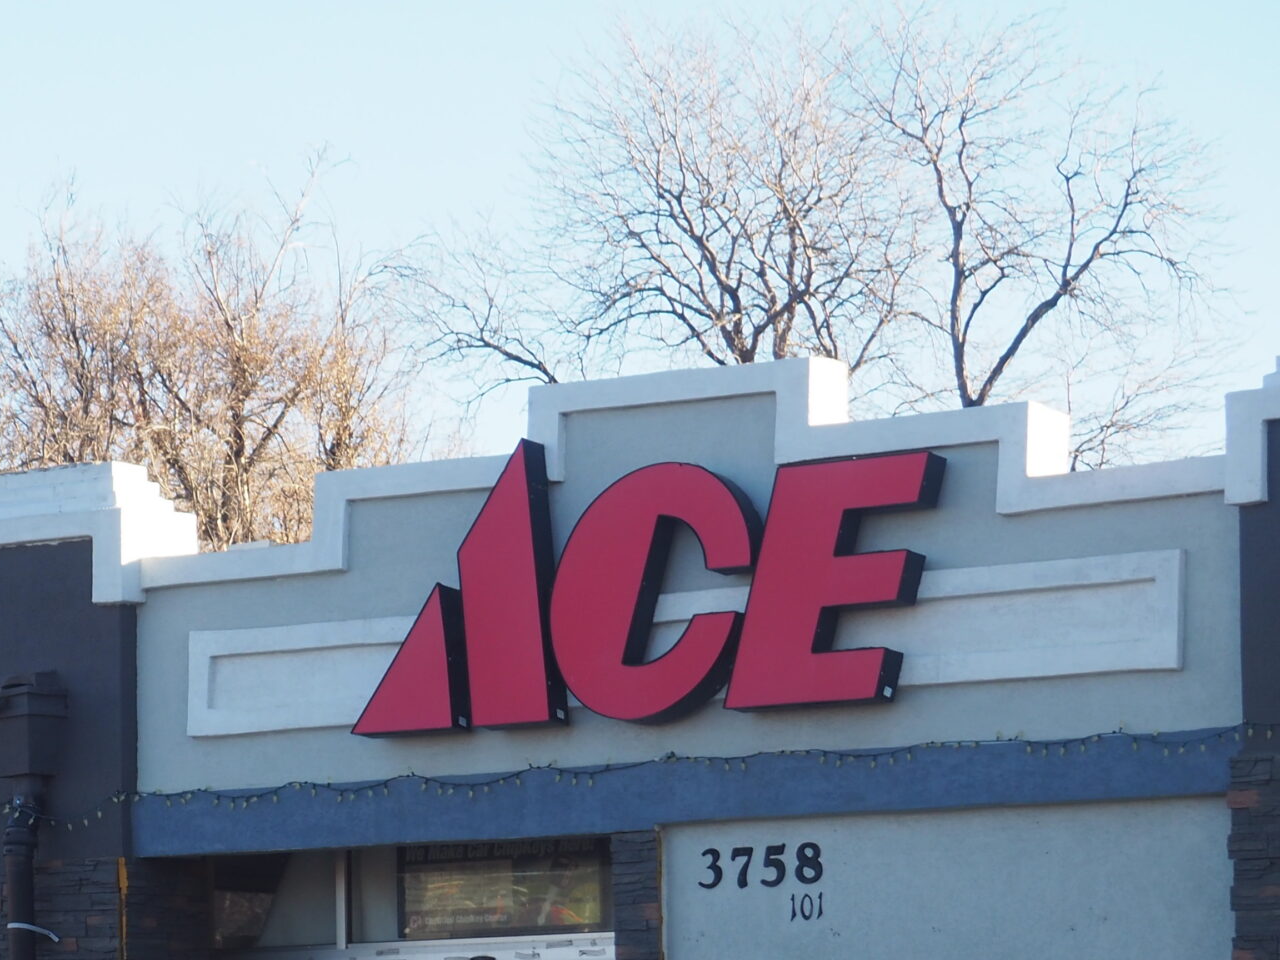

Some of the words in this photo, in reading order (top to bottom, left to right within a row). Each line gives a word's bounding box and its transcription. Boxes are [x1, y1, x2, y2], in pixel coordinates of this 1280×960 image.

[352, 438, 946, 738] ACE
[697, 842, 823, 889] 3758
[790, 891, 823, 922] 101
